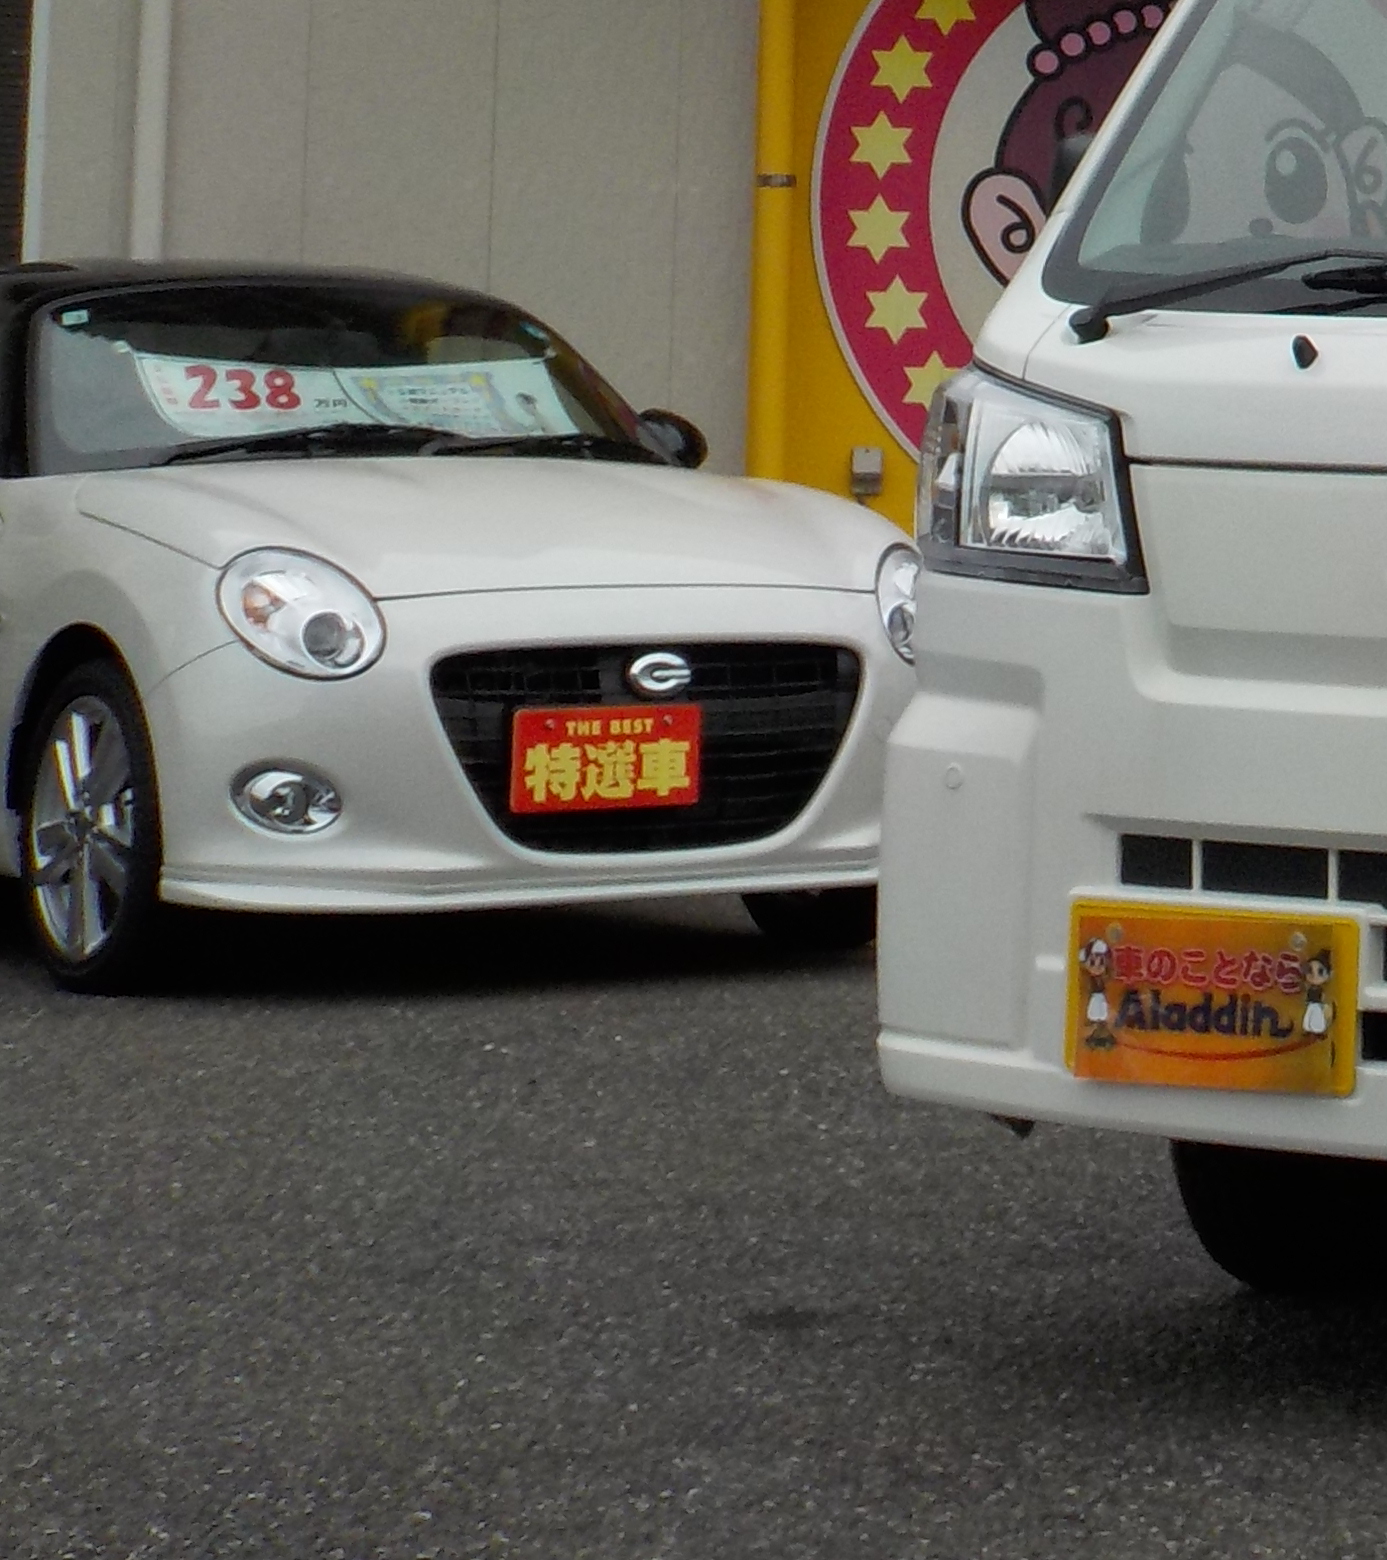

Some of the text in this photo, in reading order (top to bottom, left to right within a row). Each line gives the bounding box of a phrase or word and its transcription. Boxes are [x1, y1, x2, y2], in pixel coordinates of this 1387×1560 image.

[184, 364, 301, 411] 238
[565, 717, 654, 737] THE BEST
[523, 738, 691, 804] 特選車
[1112, 945, 1304, 995] 車のことなら
[1114, 988, 1294, 1039] Aladdin
